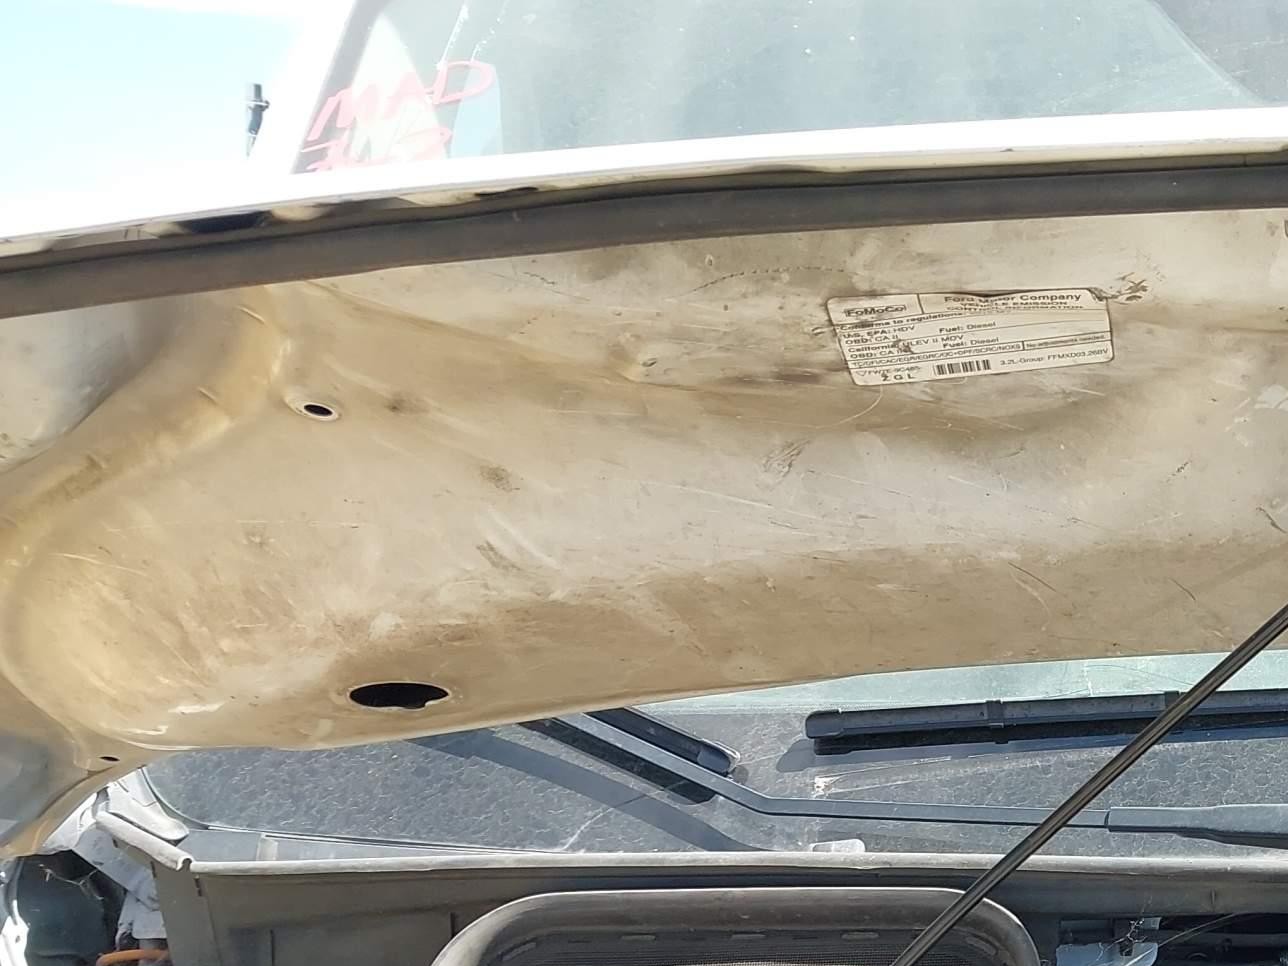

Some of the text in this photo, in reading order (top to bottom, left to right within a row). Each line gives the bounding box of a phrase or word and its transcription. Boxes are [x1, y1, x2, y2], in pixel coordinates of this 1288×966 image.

[1019, 293, 1082, 302] Company
[846, 306, 904, 317] FoMoCo
[967, 321, 997, 330] Diesel
[943, 337, 1000, 349] Fuel: Diesel
